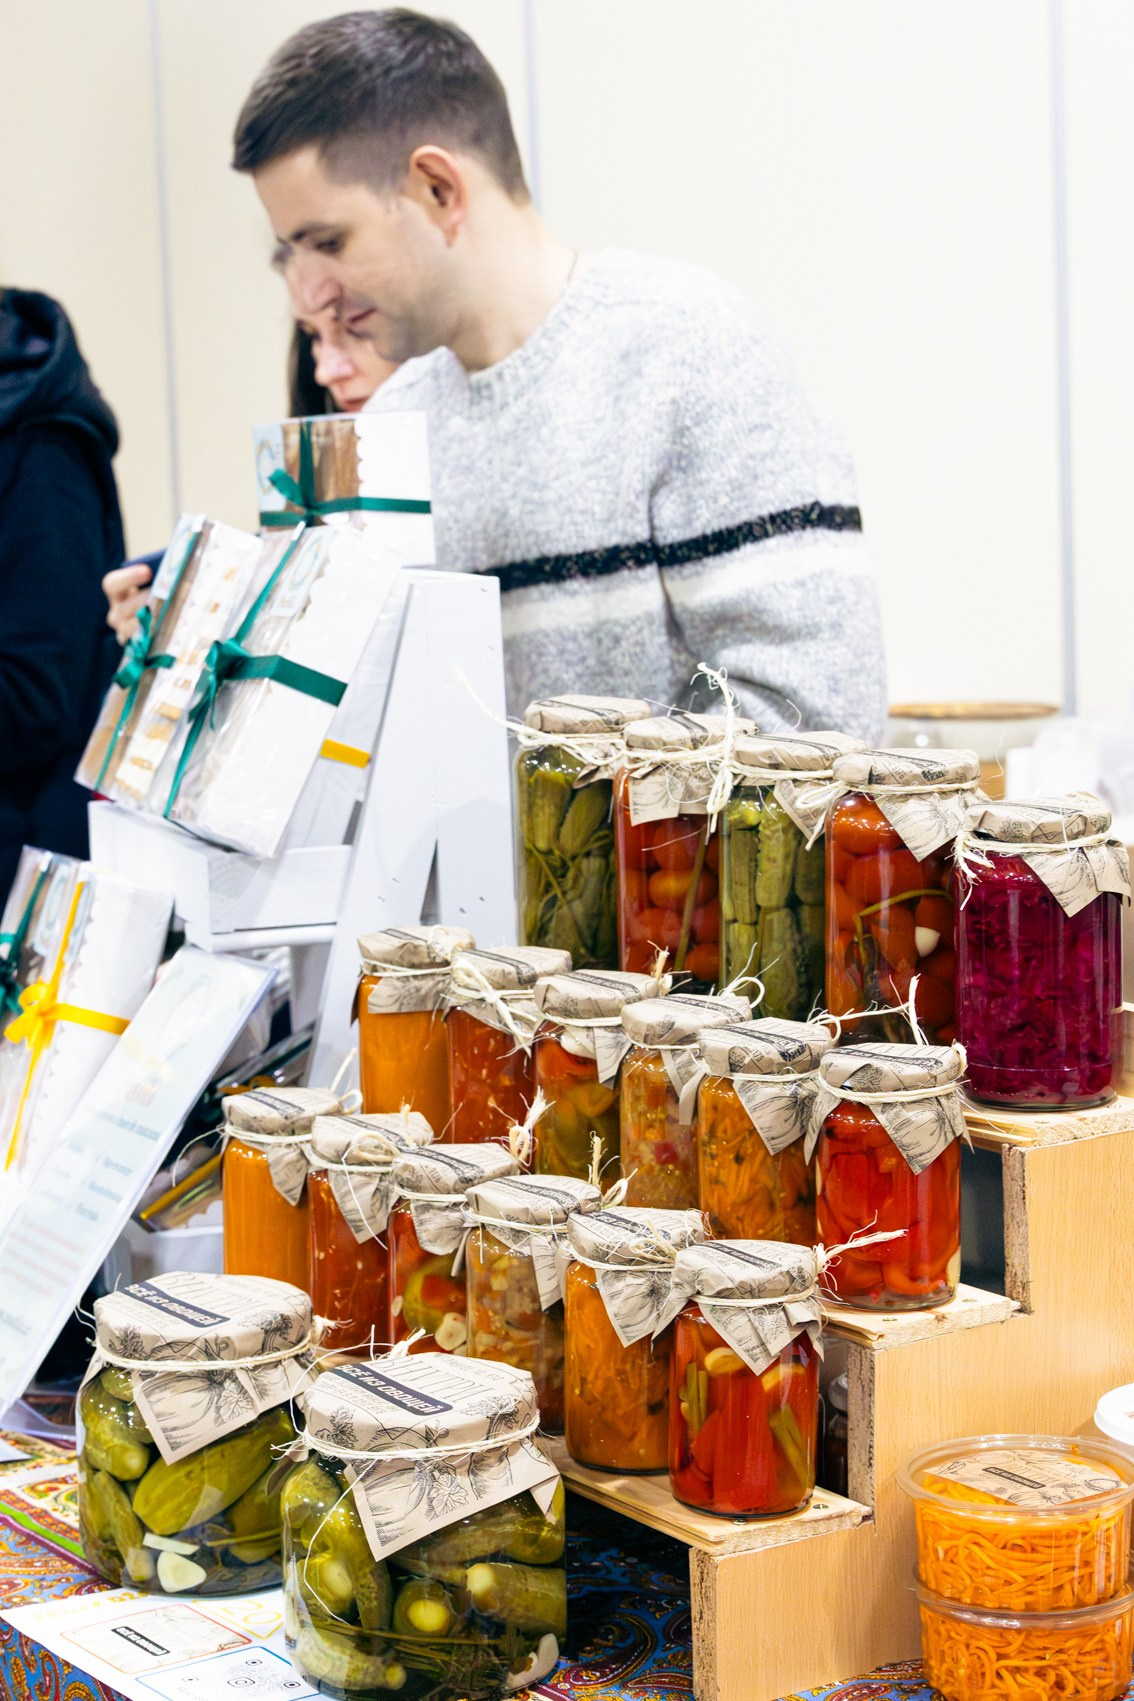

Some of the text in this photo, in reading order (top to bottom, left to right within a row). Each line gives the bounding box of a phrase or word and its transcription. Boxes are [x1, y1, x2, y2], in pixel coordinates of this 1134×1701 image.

[334, 1364, 445, 1414] ВСЁ ИЗ ОВОЩЕЙ
